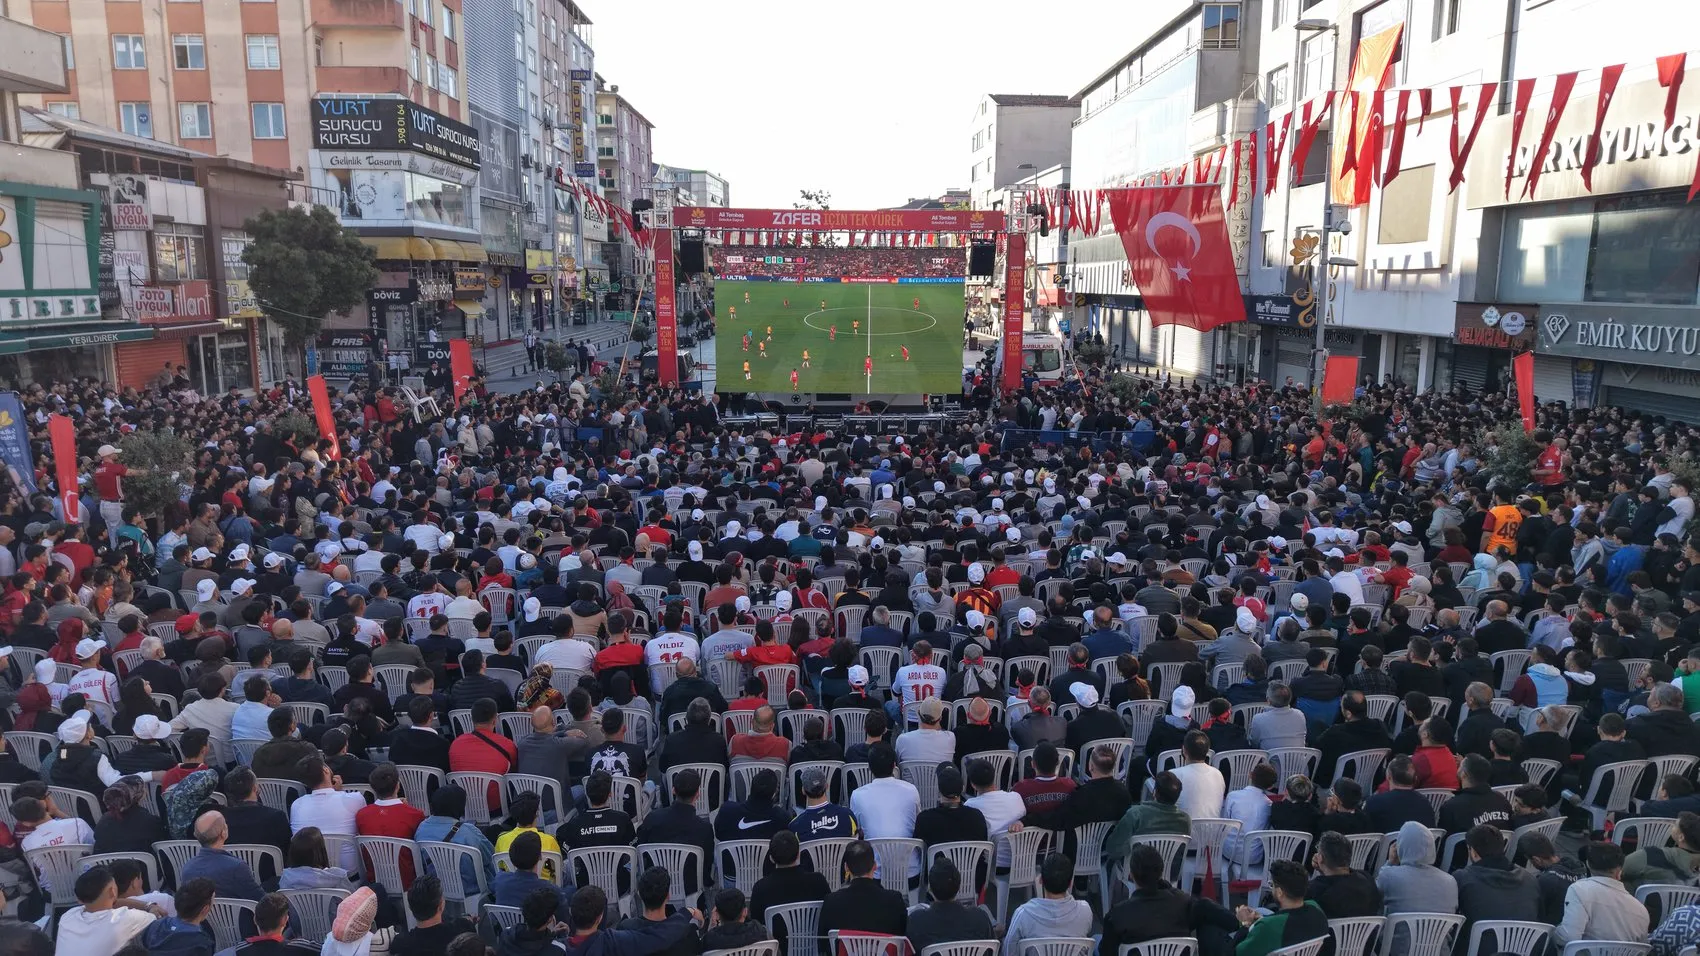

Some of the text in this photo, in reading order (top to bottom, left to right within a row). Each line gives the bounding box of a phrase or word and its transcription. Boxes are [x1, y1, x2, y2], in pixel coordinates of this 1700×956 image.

[319, 100, 370, 115] YURT
[319, 119, 382, 131] SÜRÜCÜ
[411, 108, 435, 135] YURT
[462, 134, 481, 152] KURSU
[320, 133, 371, 145] KURSU
[398, 128, 407, 144] 398
[330, 156, 362, 166] Gelinlik
[117, 205, 143, 214] FOTO
[114, 214, 149, 225] UYGUN
[772, 211, 904, 228] ZAFER İÇİN TEK YÜREK
[139, 290, 165, 300] FOTO
[174, 284, 212, 318] illant
[374, 291, 400, 299] DÖVİZ
[136, 301, 171, 312] UYGUN
[331, 338, 364, 346] PARS
[1575, 317, 1700, 355] EMİR KUYU
[428, 348, 451, 359] DÖV
[908, 671, 938, 680] ARDA GÜLER
[912, 684, 934, 701] 10
[811, 815, 839, 830] halley
